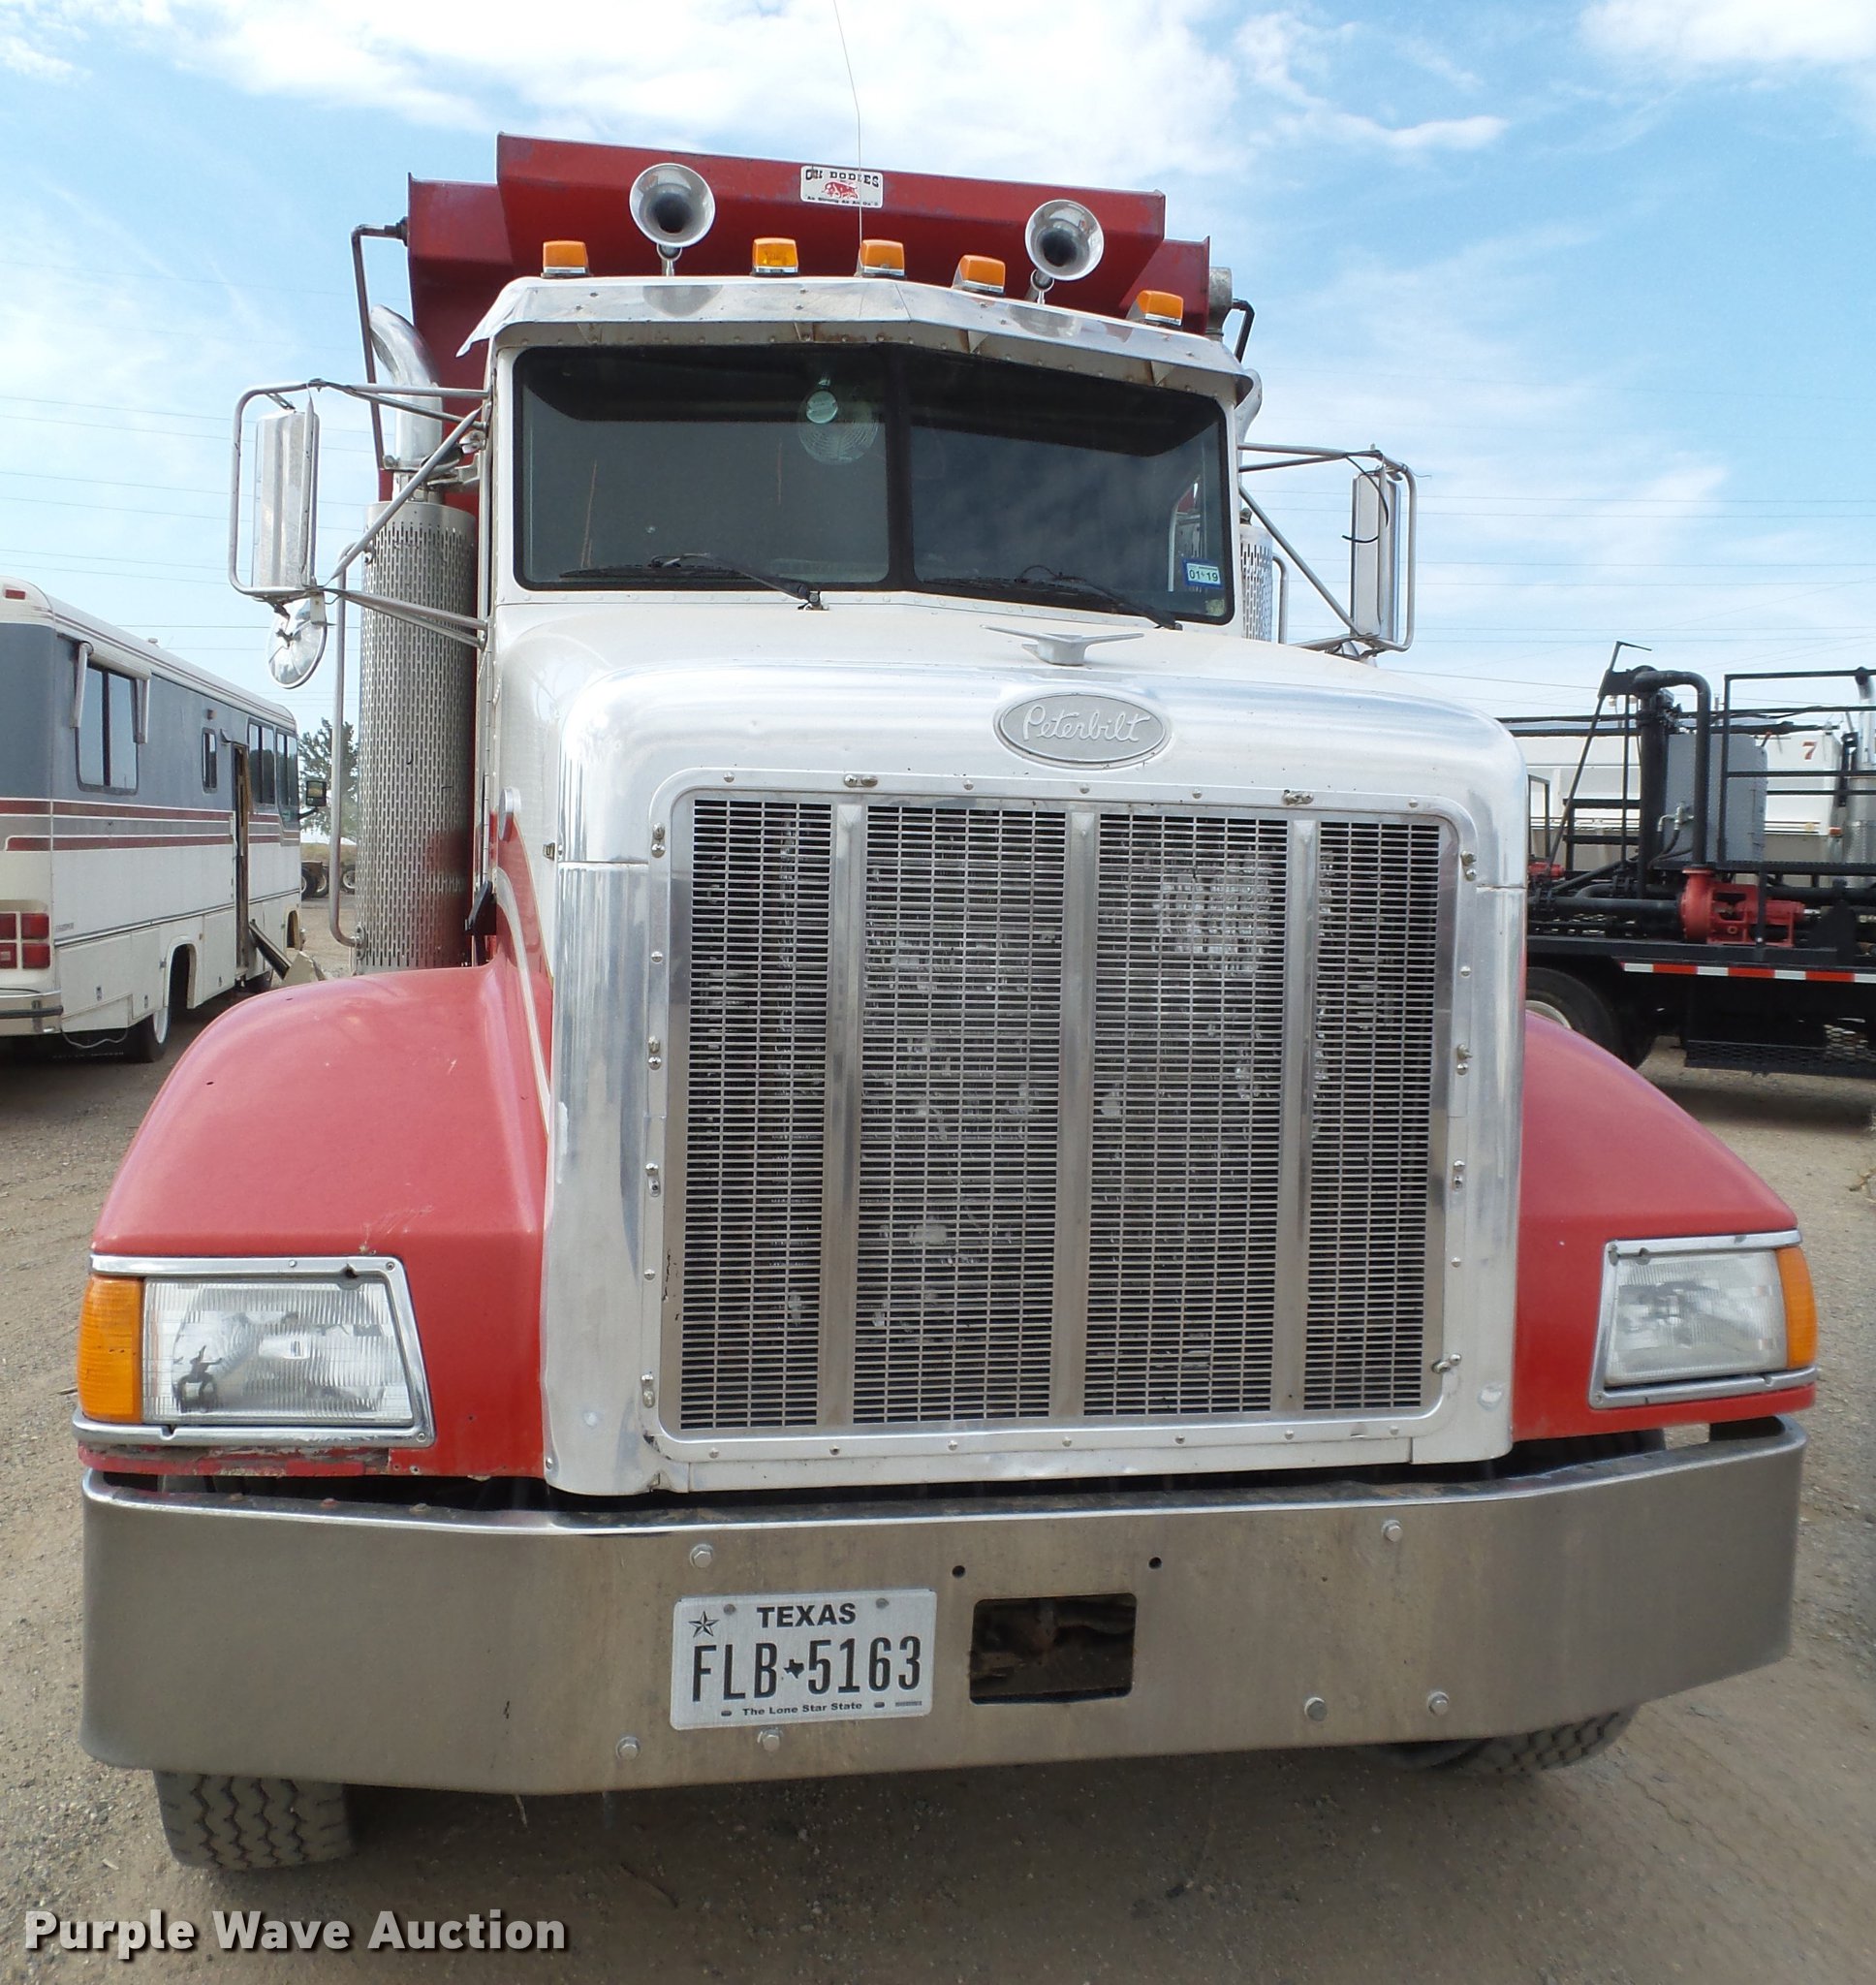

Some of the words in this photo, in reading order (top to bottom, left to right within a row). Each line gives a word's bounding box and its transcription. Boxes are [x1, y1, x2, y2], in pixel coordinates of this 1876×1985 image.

[1022, 704, 1150, 742] Peterbilt
[1801, 741, 1818, 760] 7
[756, 1602, 857, 1628] TEXAS
[742, 1707, 766, 1717] The
[768, 1705, 798, 1715] Lone
[801, 1703, 829, 1714] Star
[830, 1701, 862, 1712] State
